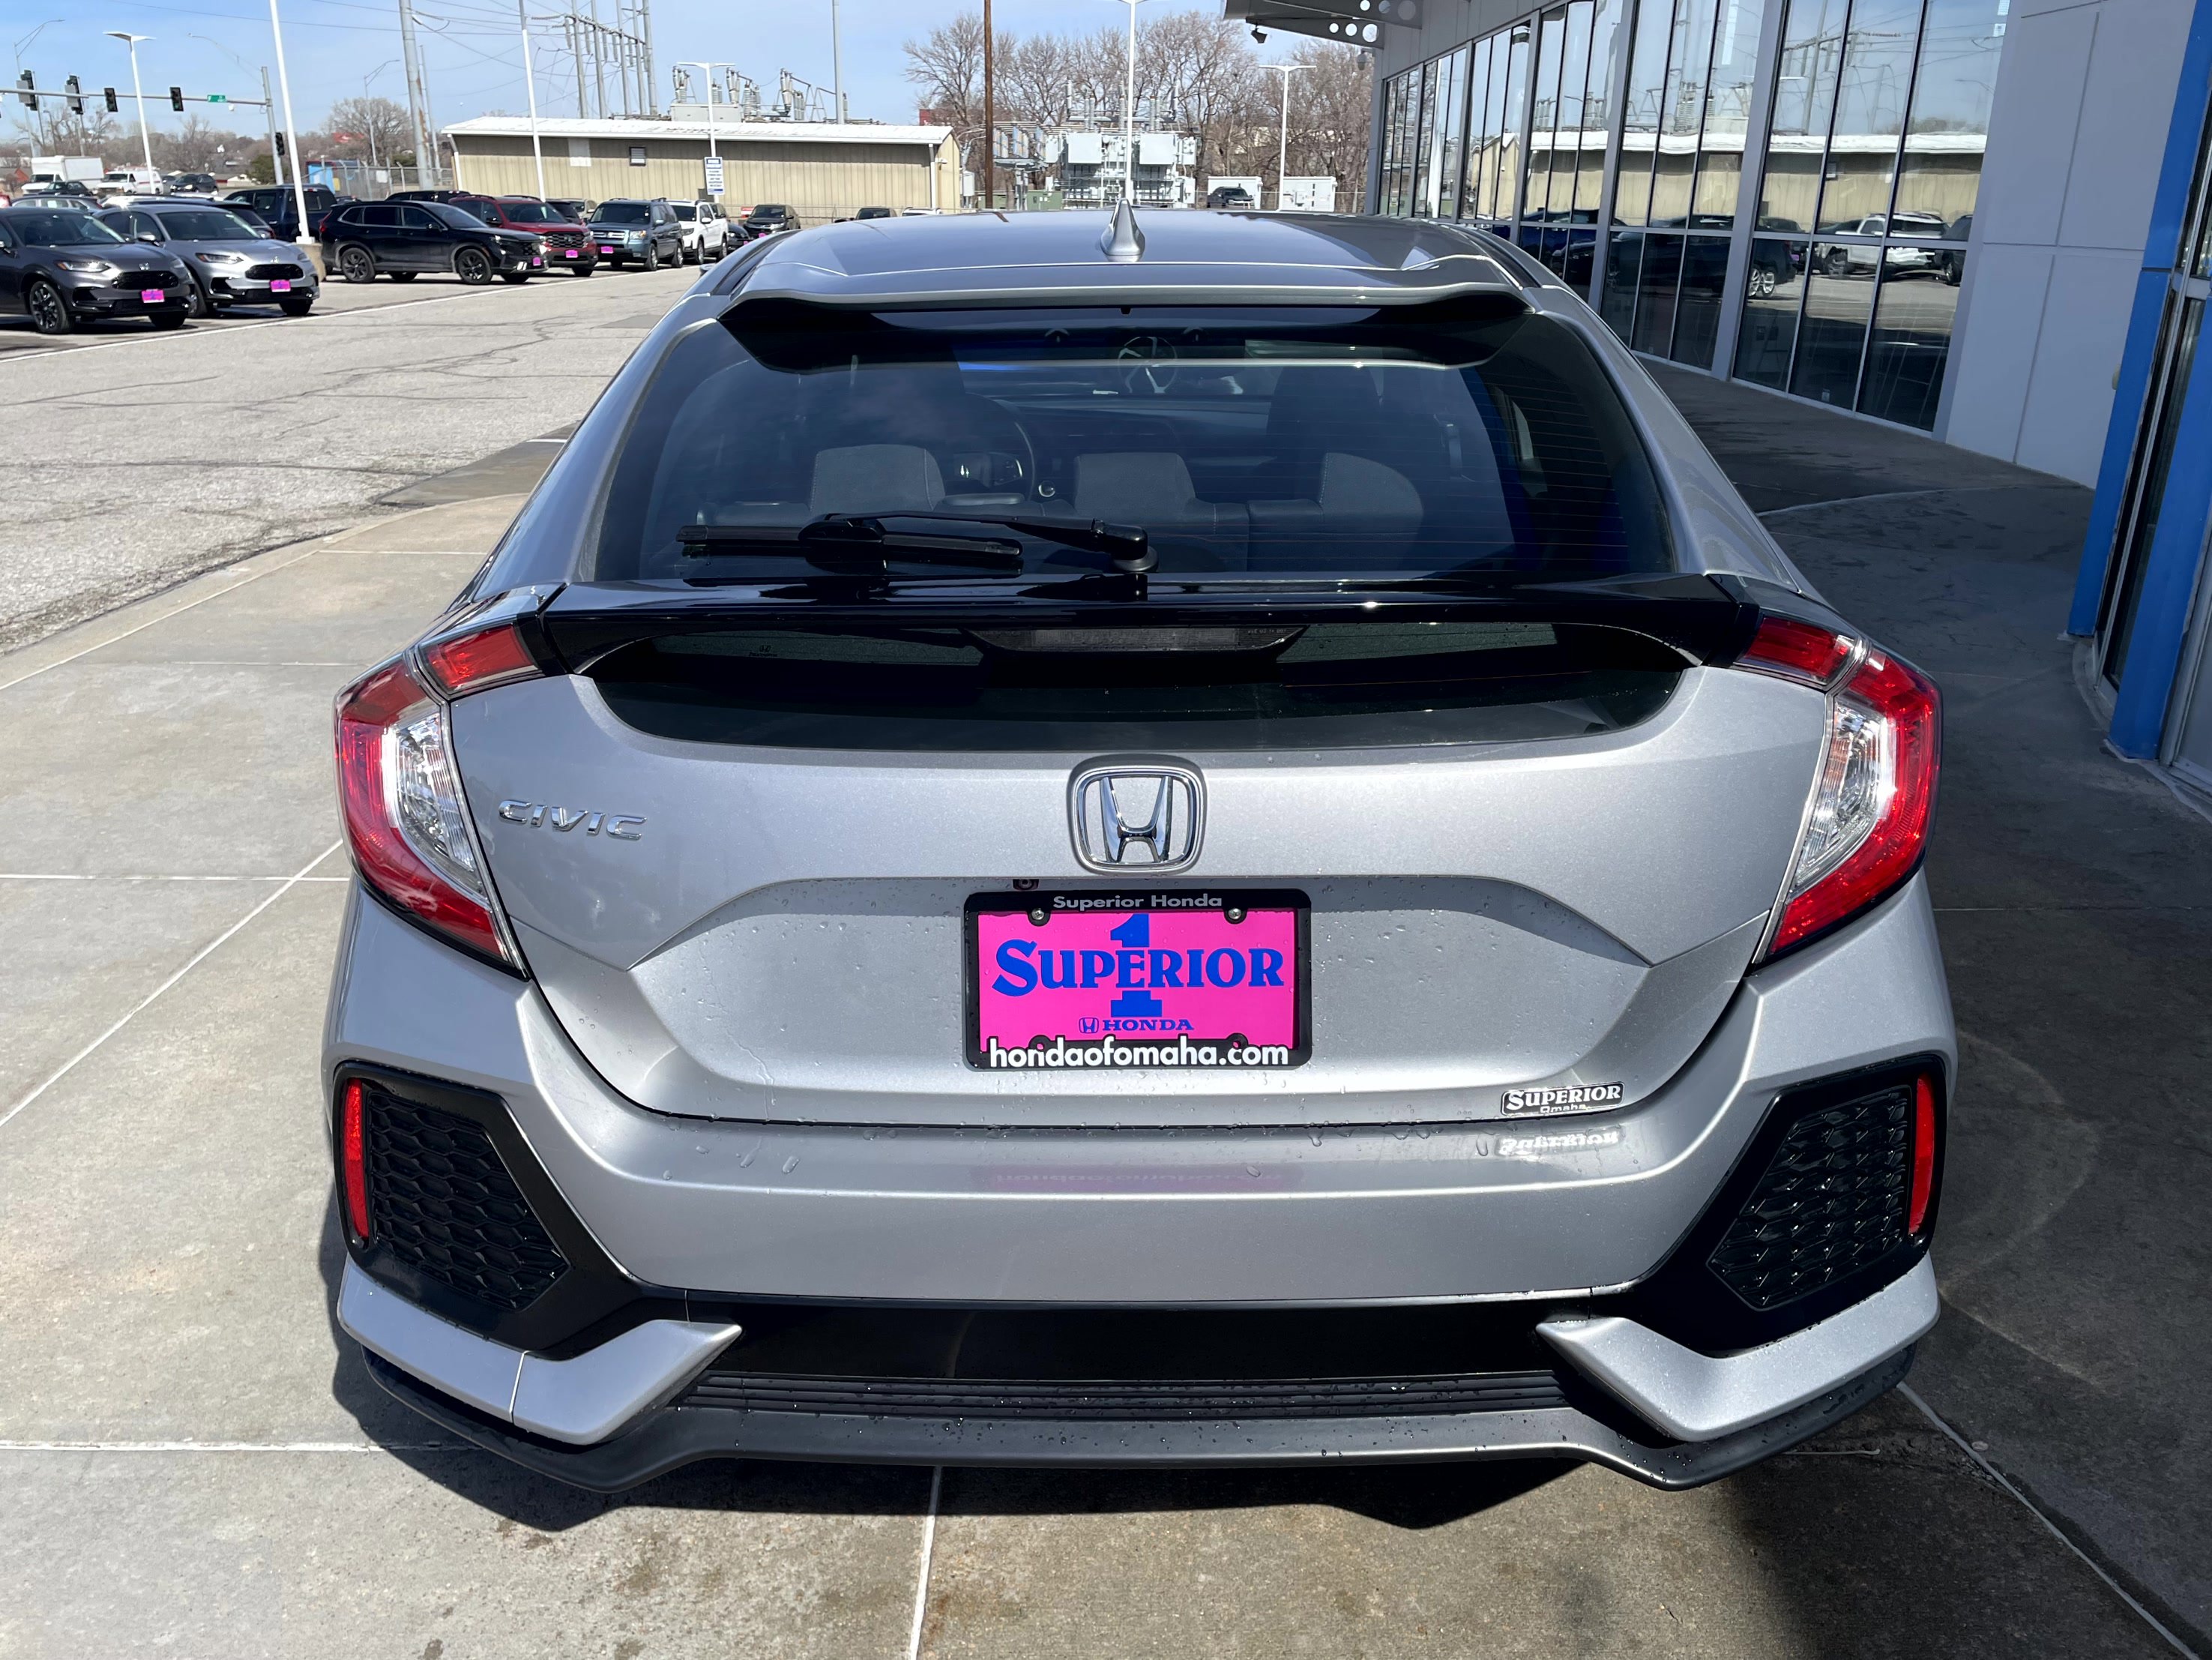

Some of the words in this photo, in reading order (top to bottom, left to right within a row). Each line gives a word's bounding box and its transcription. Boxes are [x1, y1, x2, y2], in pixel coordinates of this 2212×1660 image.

[498, 799, 648, 840] CIVIC
[1053, 894, 1144, 911] Superior
[1151, 893, 1222, 907] Honda
[991, 939, 1285, 997] SUPERIOR
[1102, 1019, 1195, 1032] HONDA
[989, 1035, 1289, 1068] hondaofomaha.com
[1506, 1085, 1621, 1110] SUPERIOR
